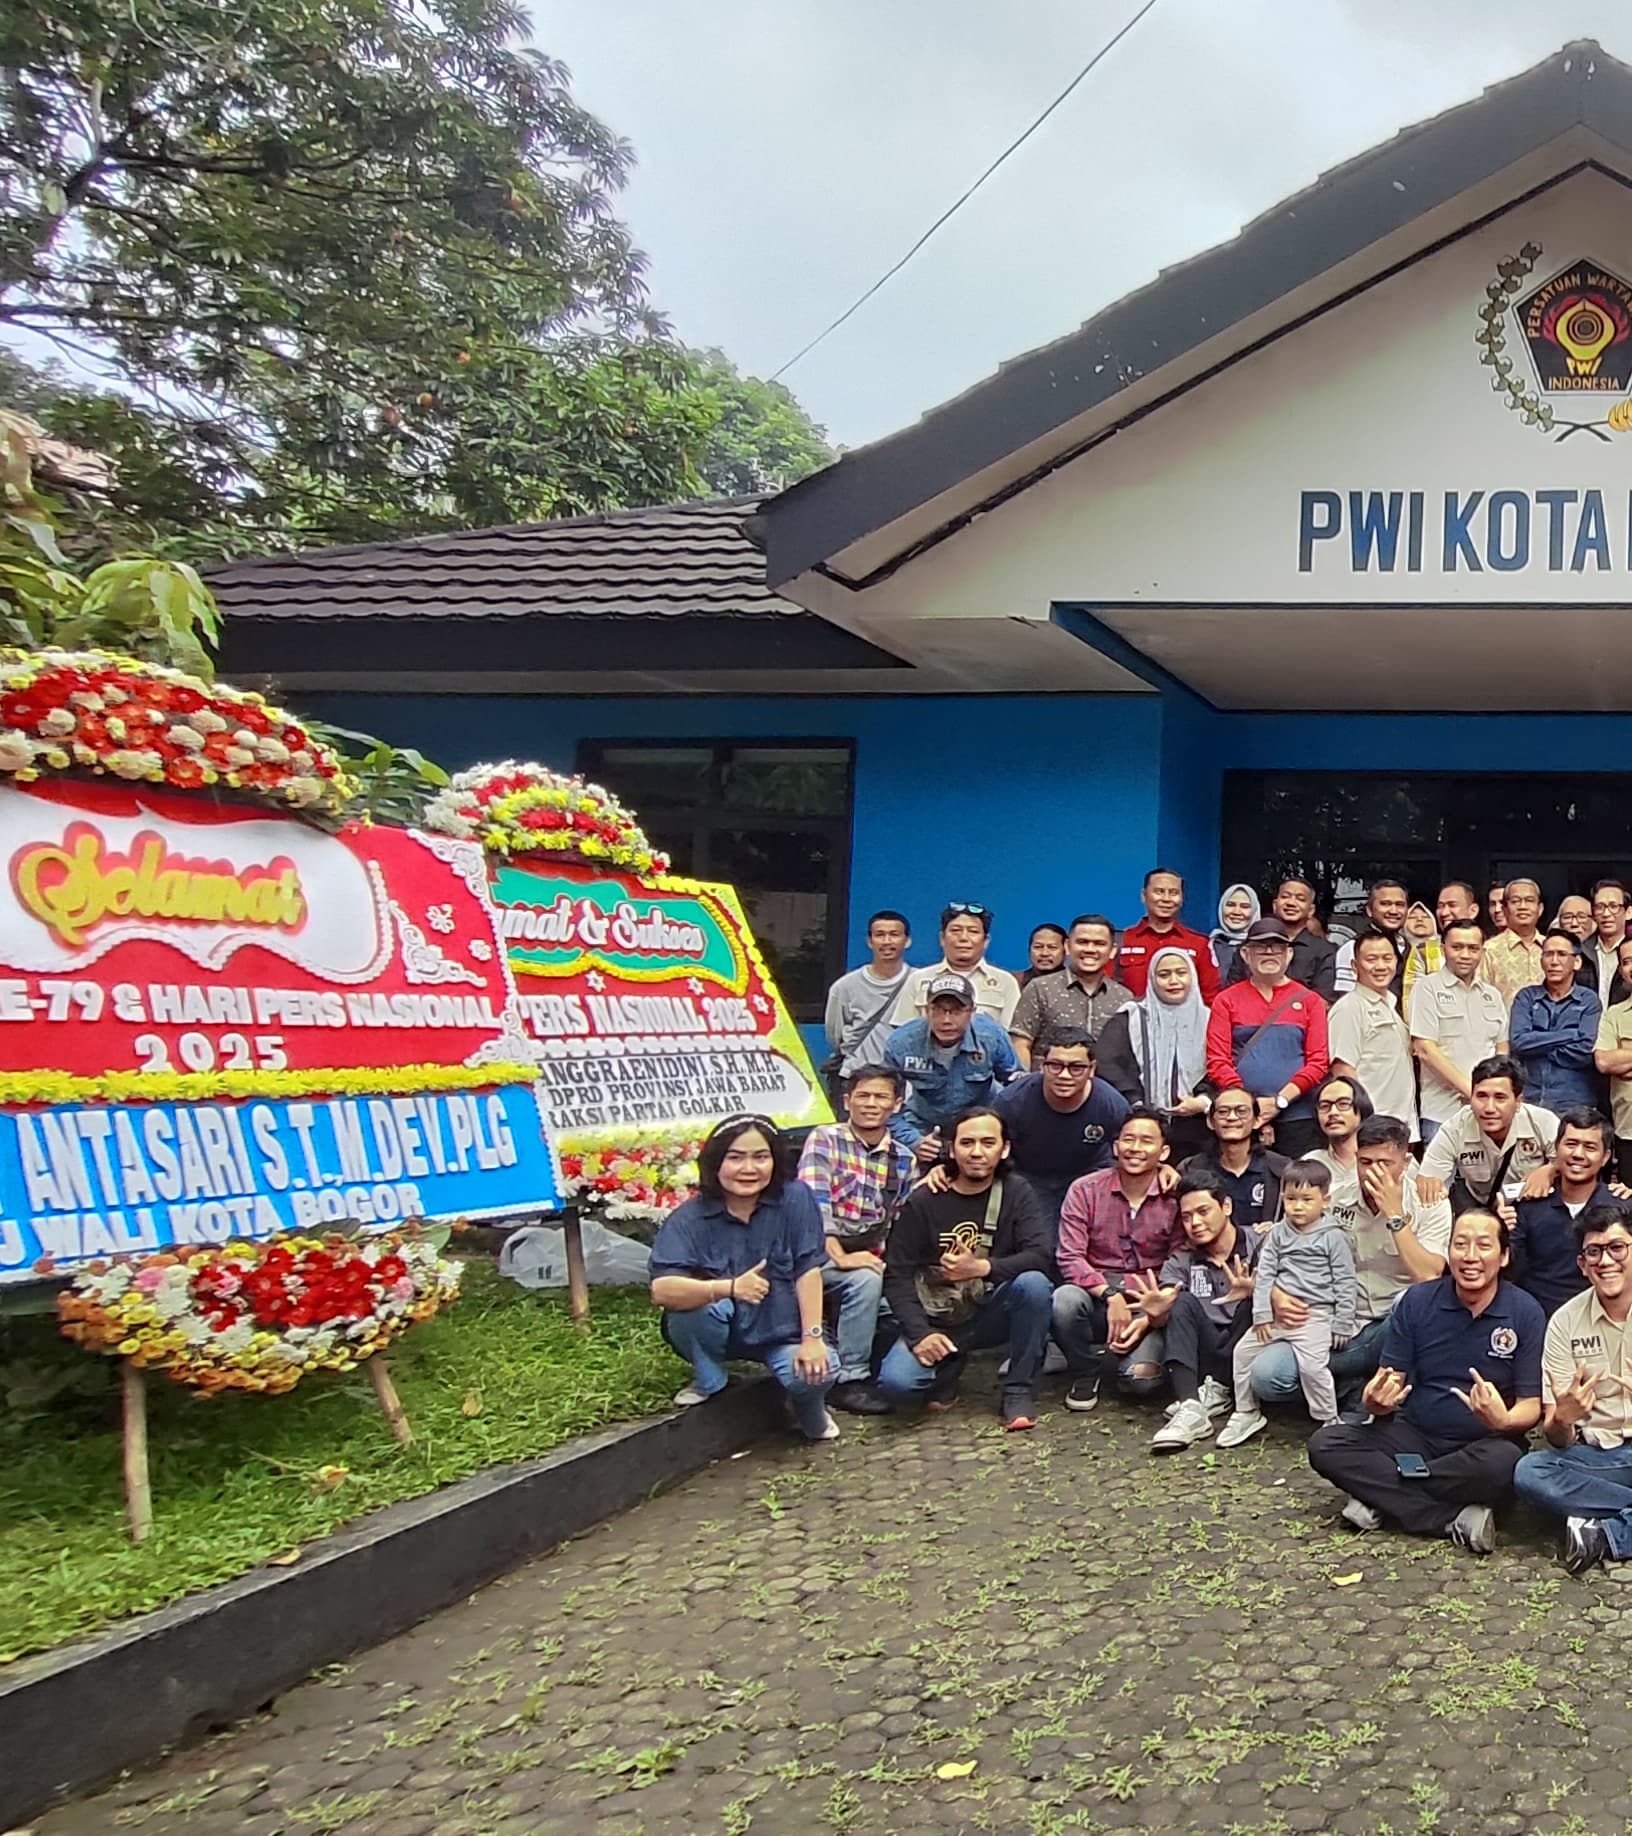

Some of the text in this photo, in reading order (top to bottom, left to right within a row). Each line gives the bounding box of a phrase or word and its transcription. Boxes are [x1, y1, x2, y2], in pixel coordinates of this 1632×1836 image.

[1528, 272, 1581, 338] PERSATUAN
[1548, 376, 1620, 390] INDONESIA
[1566, 356, 1603, 375] PWI
[1299, 490, 1424, 572] PWI
[1442, 489, 1612, 573] KOTA
[18, 834, 301, 945] Selamat
[577, 899, 610, 945] &
[612, 903, 704, 951] Sukses
[112, 983, 147, 1023] &
[148, 984, 253, 1024] HARI
[253, 988, 347, 1027] PERS
[344, 993, 504, 1030] NASIONAL
[585, 996, 708, 1033] NASIONAL
[701, 997, 757, 1031] 2025
[135, 1032, 288, 1073] 2025
[904, 1056, 935, 1071] PWI
[549, 1074, 788, 1106] DPRD PROVINSI JAWA BARAT
[608, 1099, 677, 1125] PARTAI
[678, 1096, 747, 1114] GOLKAR
[16, 1105, 257, 1213] ANTASARI
[1460, 1150, 1485, 1162] PWI
[30, 1211, 161, 1258] WALI
[167, 1195, 286, 1246] KOTA
[289, 1183, 426, 1228] BOGOR
[1332, 1206, 1356, 1221] PWI
[1571, 1335, 1601, 1351] PWI
